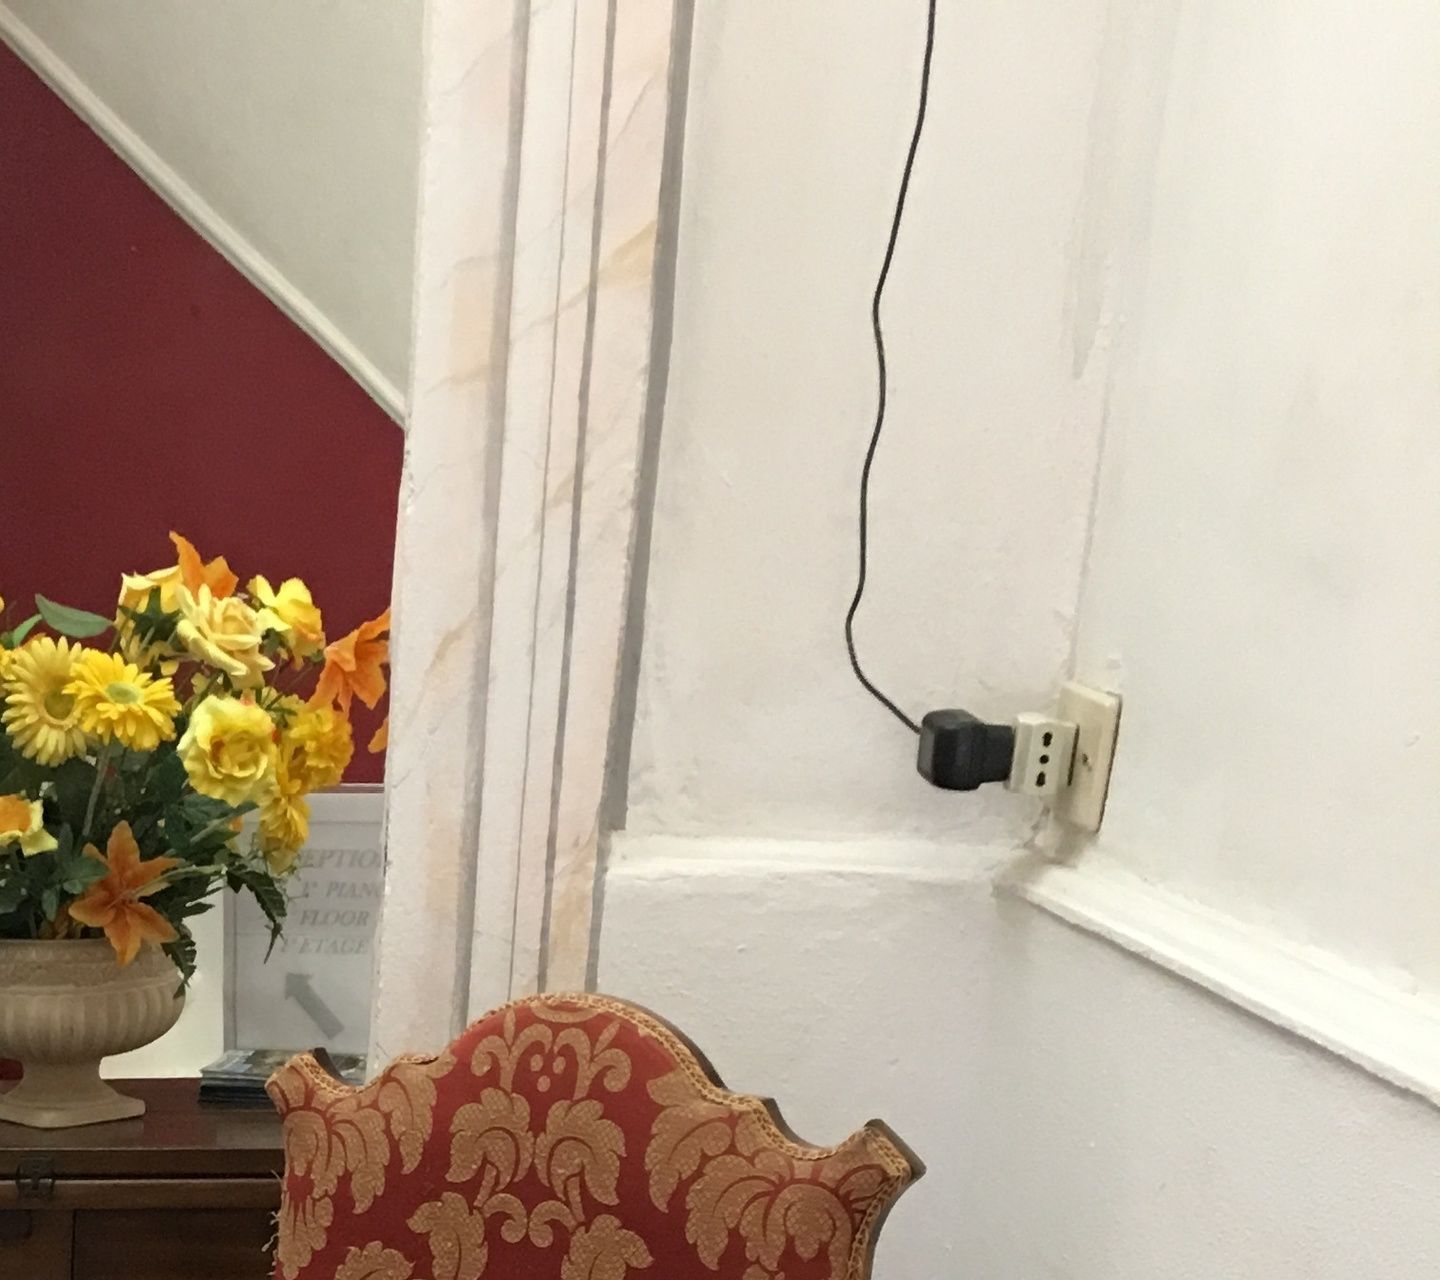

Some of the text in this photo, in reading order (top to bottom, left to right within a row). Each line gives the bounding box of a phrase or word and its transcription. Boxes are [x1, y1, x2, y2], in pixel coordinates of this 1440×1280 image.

[300, 848, 381, 868] EPTIO
[300, 909, 370, 927] FLOOR
[299, 938, 371, 955] ETAGE
